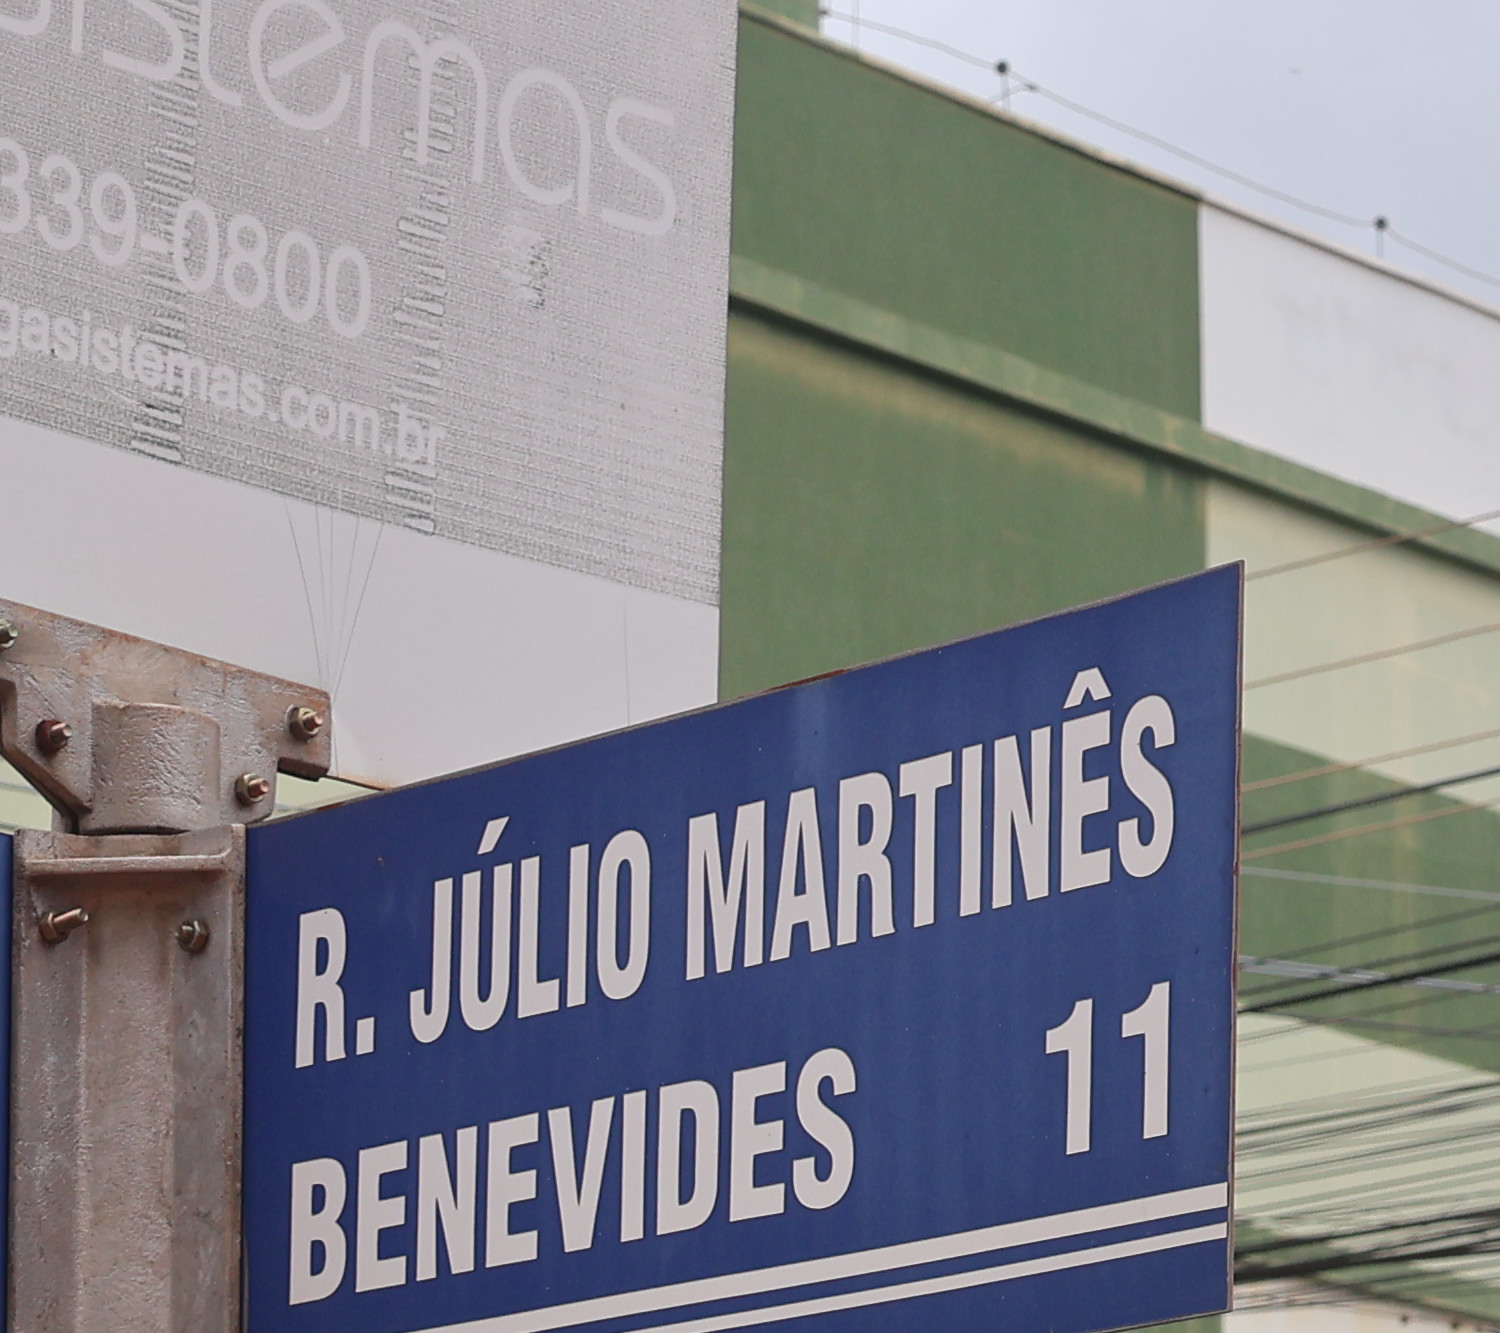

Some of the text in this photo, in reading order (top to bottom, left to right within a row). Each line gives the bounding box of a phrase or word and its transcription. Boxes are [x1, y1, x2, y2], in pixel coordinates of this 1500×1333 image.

[294, 667, 1176, 1070] R. JÚLIO MARTINÊS
[288, 1048, 857, 1306] BENEVIDES
[1045, 981, 1171, 1156] 11
